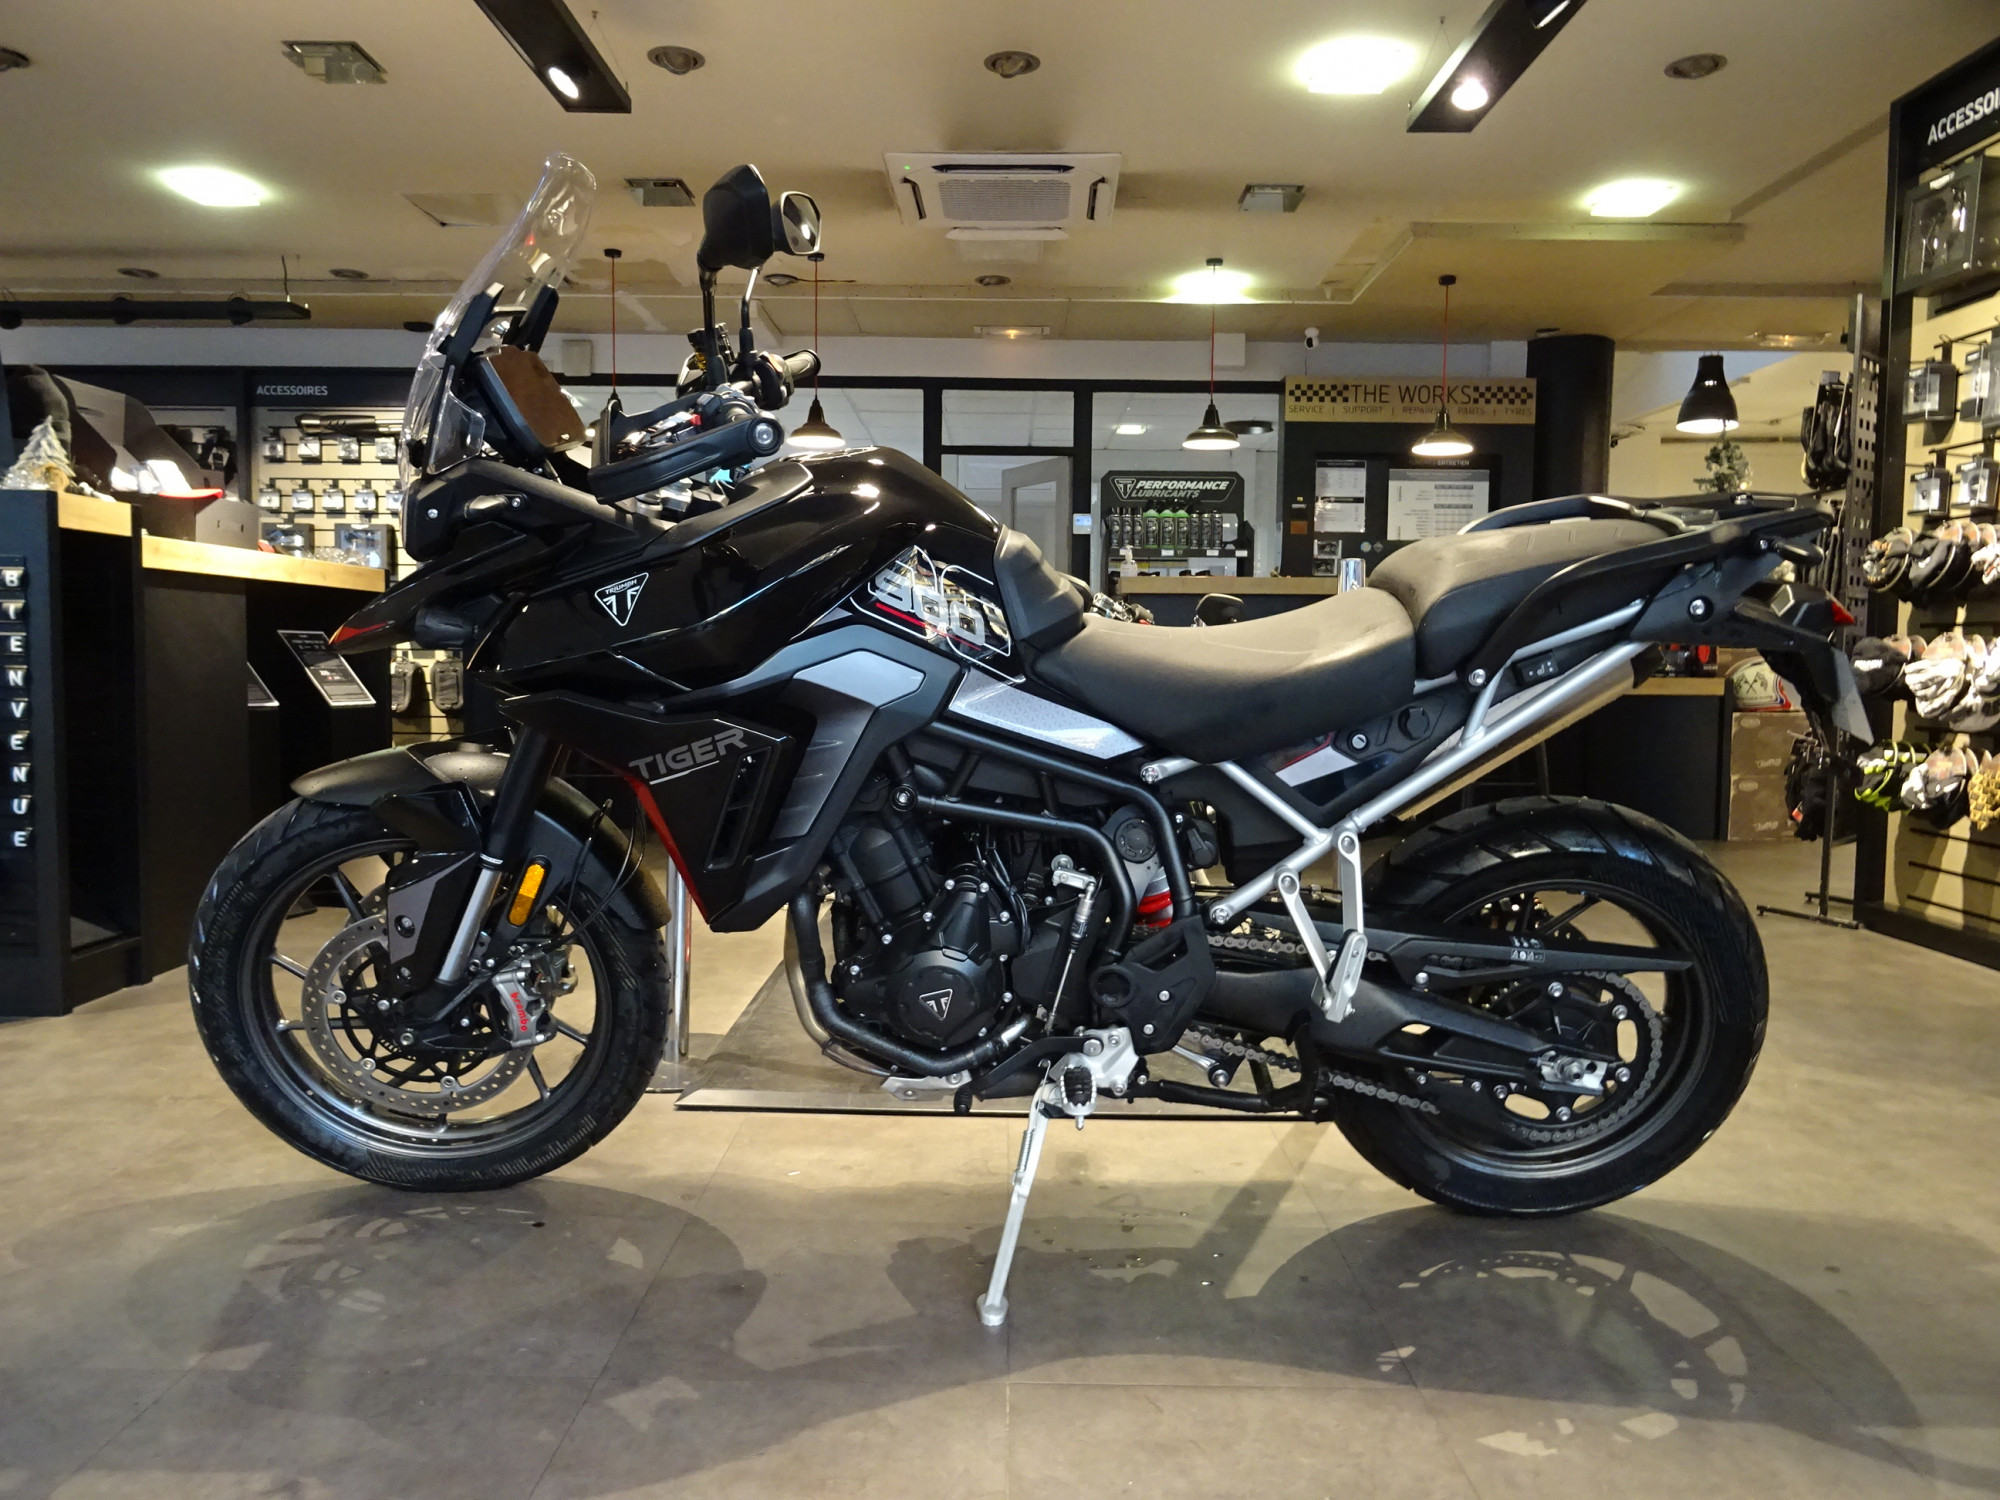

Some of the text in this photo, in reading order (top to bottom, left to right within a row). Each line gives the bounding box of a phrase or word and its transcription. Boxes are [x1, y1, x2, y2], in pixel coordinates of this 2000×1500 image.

[1926, 86, 2000, 147] ACCESSOI
[256, 385, 329, 396] ACCESSOIRES
[1351, 384, 1472, 405] THE WORKS
[1288, 405, 1325, 414] SERVICE
[1342, 405, 1383, 415] SUPPORT
[1457, 406, 1486, 416] PARTS
[1504, 407, 1533, 417] TYRES
[1130, 488, 1201, 498] LUBRICANTS
[1135, 480, 1229, 490] PERFORMANCE
[604, 579, 638, 595] TRIUMPH
[3, 569, 30, 848] BIENVENUE
[628, 727, 749, 780] TIGER
[510, 991, 531, 1033] brembo
